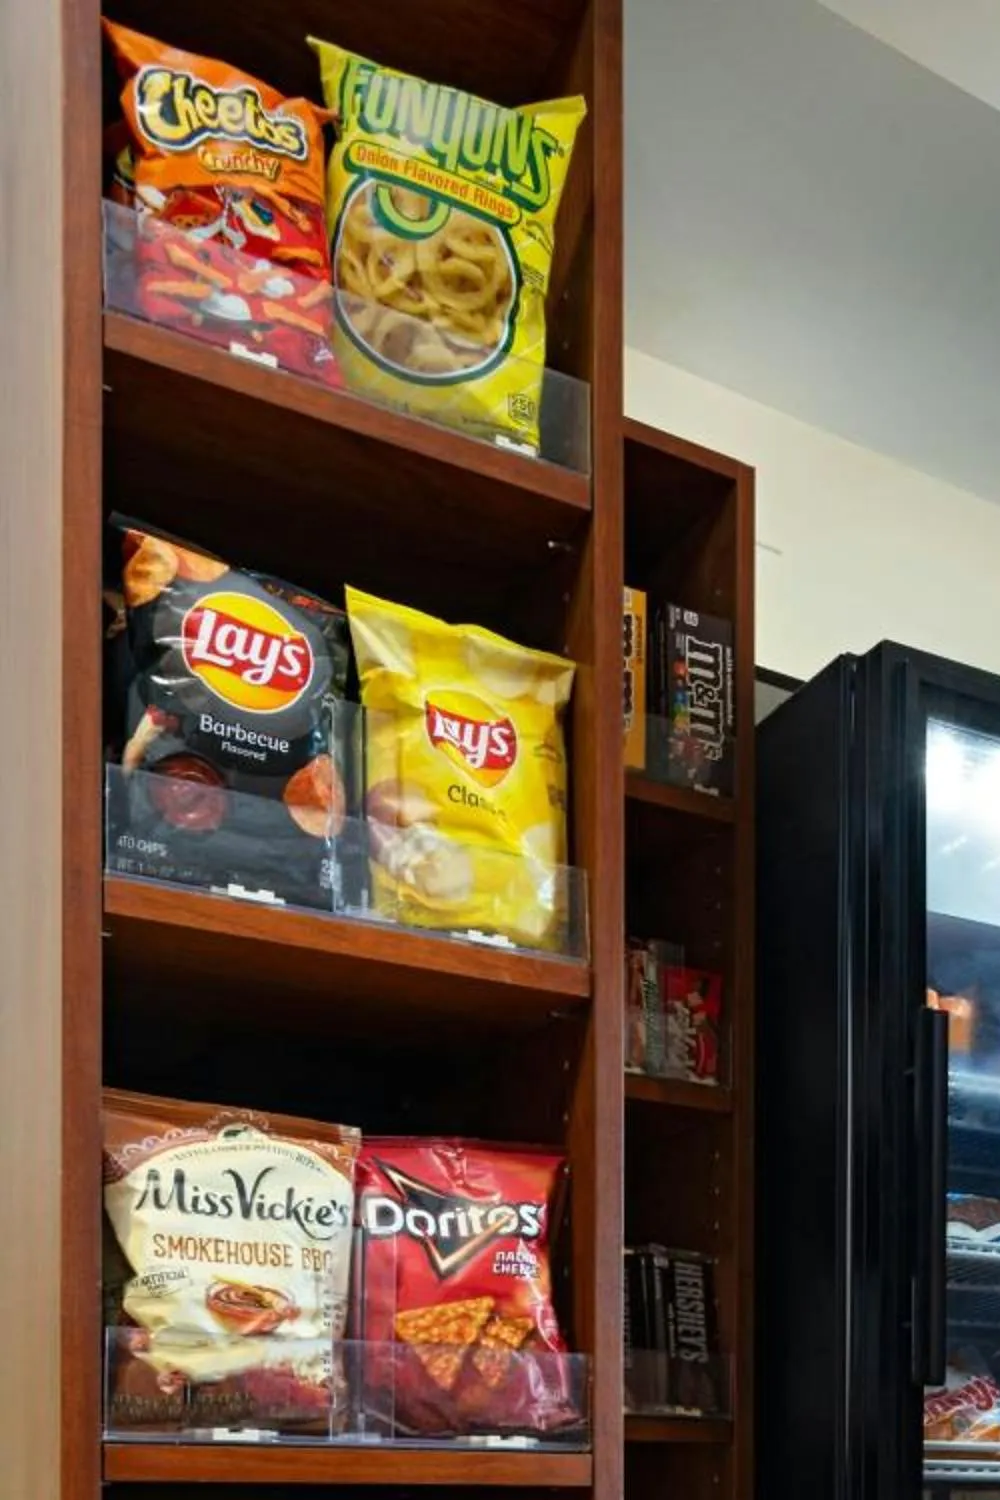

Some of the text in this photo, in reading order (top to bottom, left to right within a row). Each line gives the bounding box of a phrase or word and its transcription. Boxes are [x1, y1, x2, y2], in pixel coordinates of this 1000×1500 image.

[138, 68, 305, 156] Cheetos
[343, 58, 555, 211] FUNYUNS
[200, 147, 280, 179] Crunchy
[356, 145, 399, 171] Onion
[404, 160, 468, 196] Flavored
[473, 185, 513, 219] Rings
[192, 608, 307, 686] Lay's
[199, 712, 291, 755] Barbecue
[220, 740, 268, 763] Flavored
[431, 709, 512, 766] Lay's
[135, 1166, 350, 1241] Miss Vickie's
[363, 1198, 543, 1238] Doritos
[152, 1233, 294, 1268] SMOKEHOUSE
